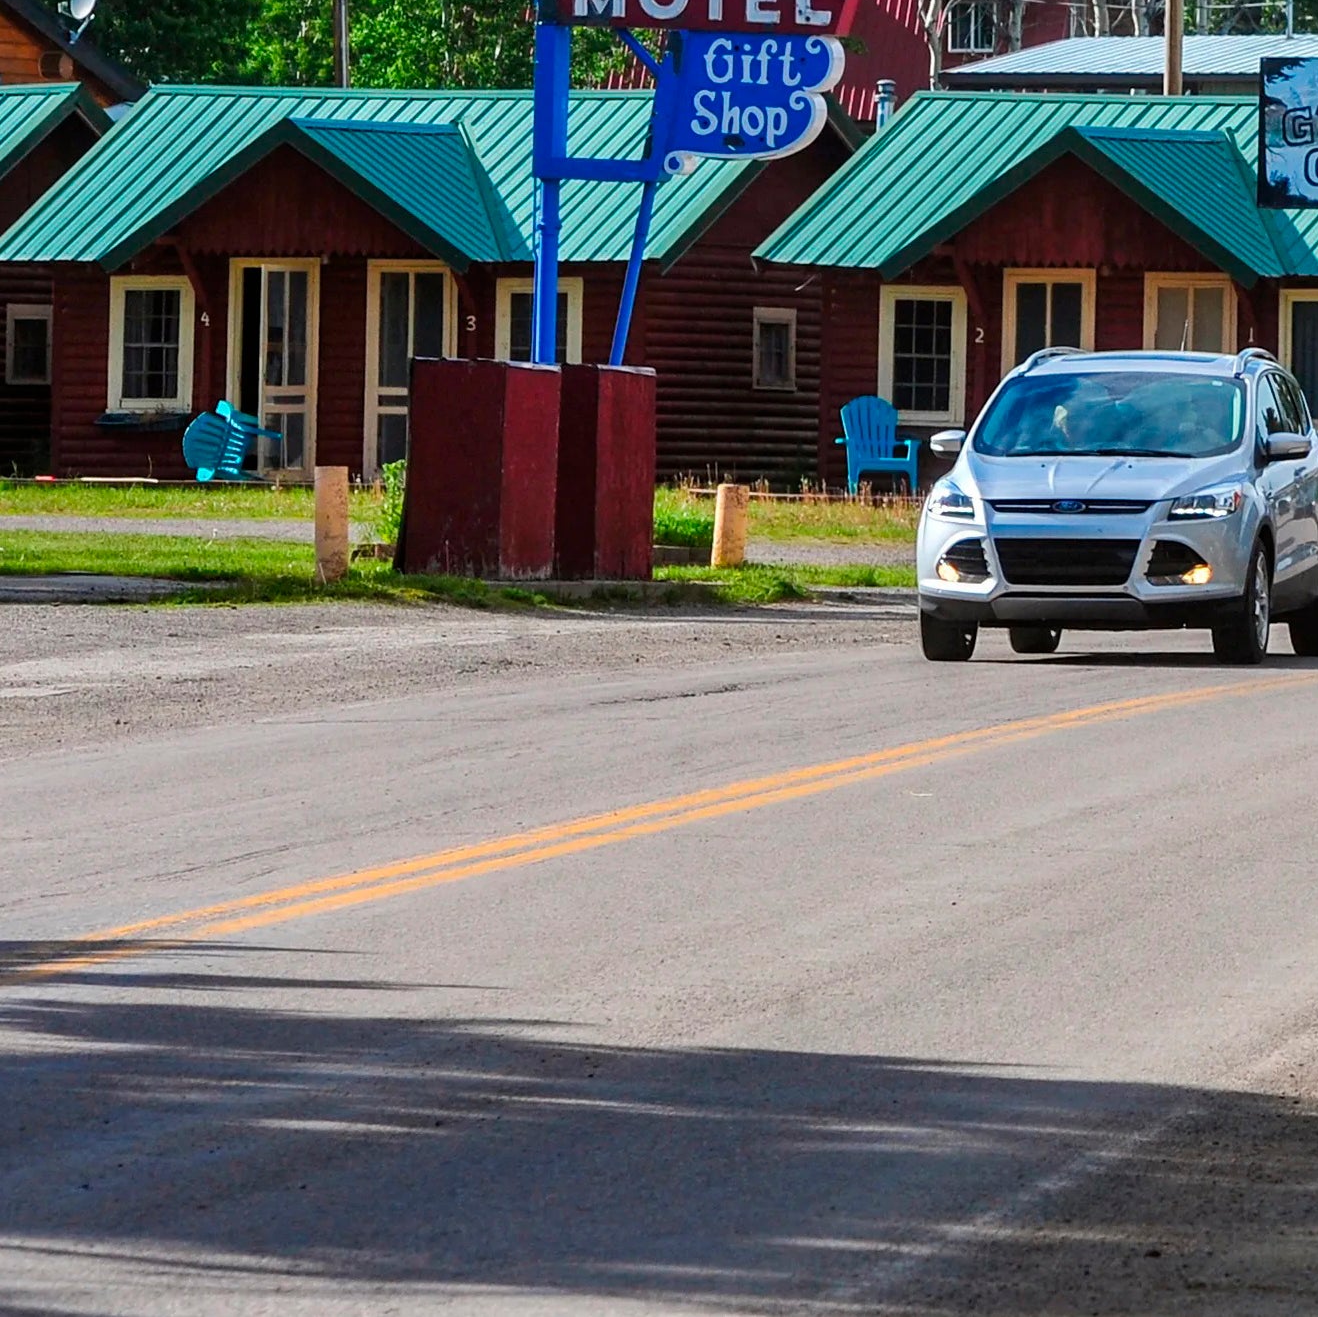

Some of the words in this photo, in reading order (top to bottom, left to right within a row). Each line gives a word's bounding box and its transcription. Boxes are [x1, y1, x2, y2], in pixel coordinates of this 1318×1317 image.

[703, 38, 802, 87] Gift
[690, 90, 788, 148] Shop
[200, 311, 210, 327] 4
[466, 315, 477, 332] 3
[974, 327, 985, 344] 2
[1247, 326, 1255, 343] 1
